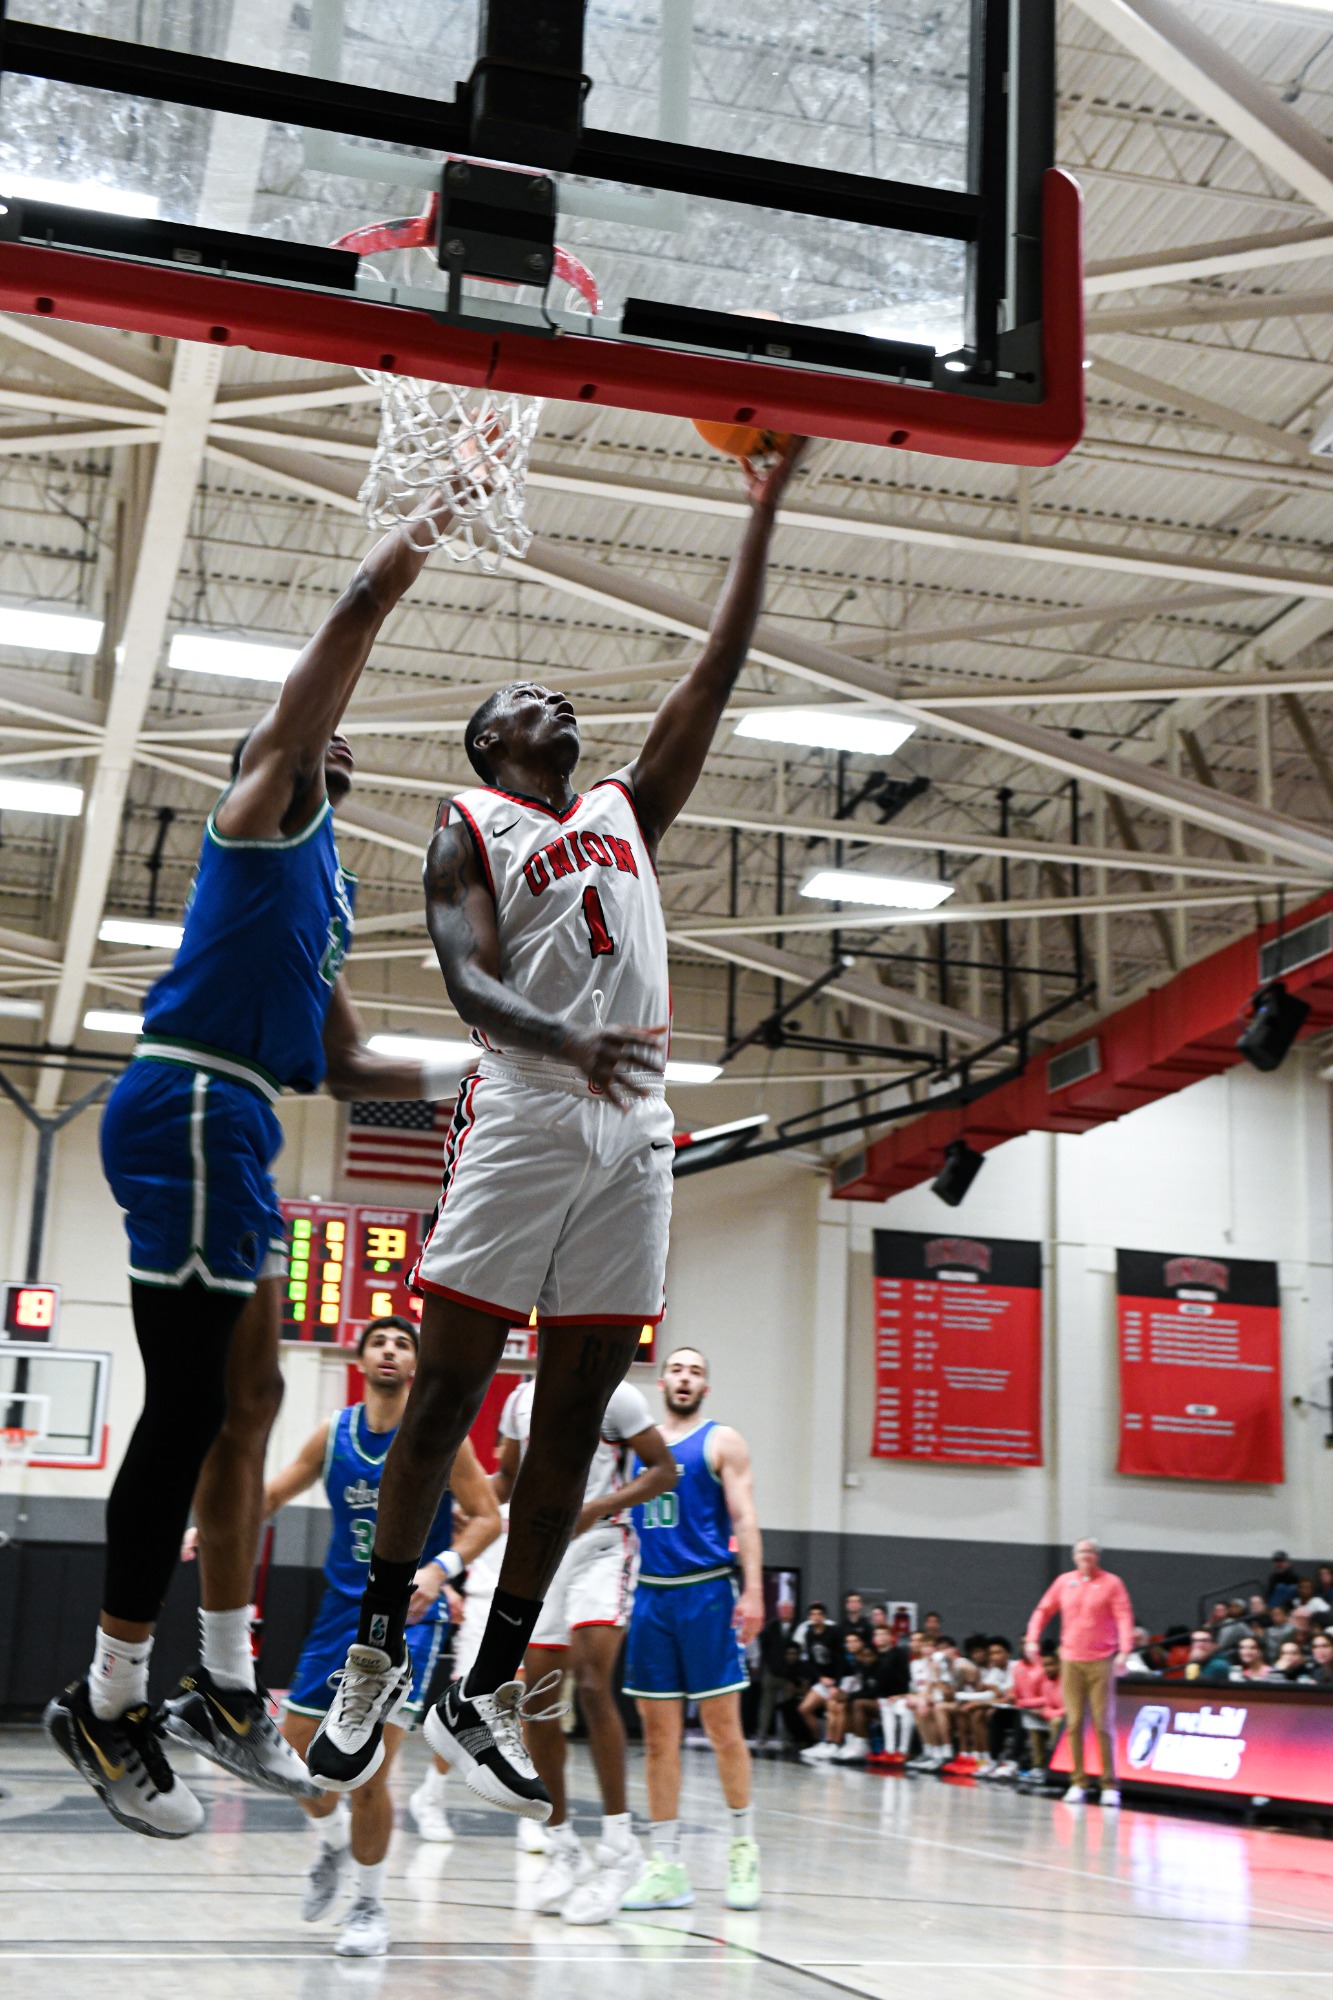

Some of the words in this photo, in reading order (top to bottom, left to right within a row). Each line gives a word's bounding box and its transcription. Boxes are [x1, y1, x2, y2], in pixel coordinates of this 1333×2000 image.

[523, 830, 639, 897] UNION
[581, 885, 614, 959] 1
[642, 1492, 680, 1529] 10
[350, 1518, 376, 1562] 3
